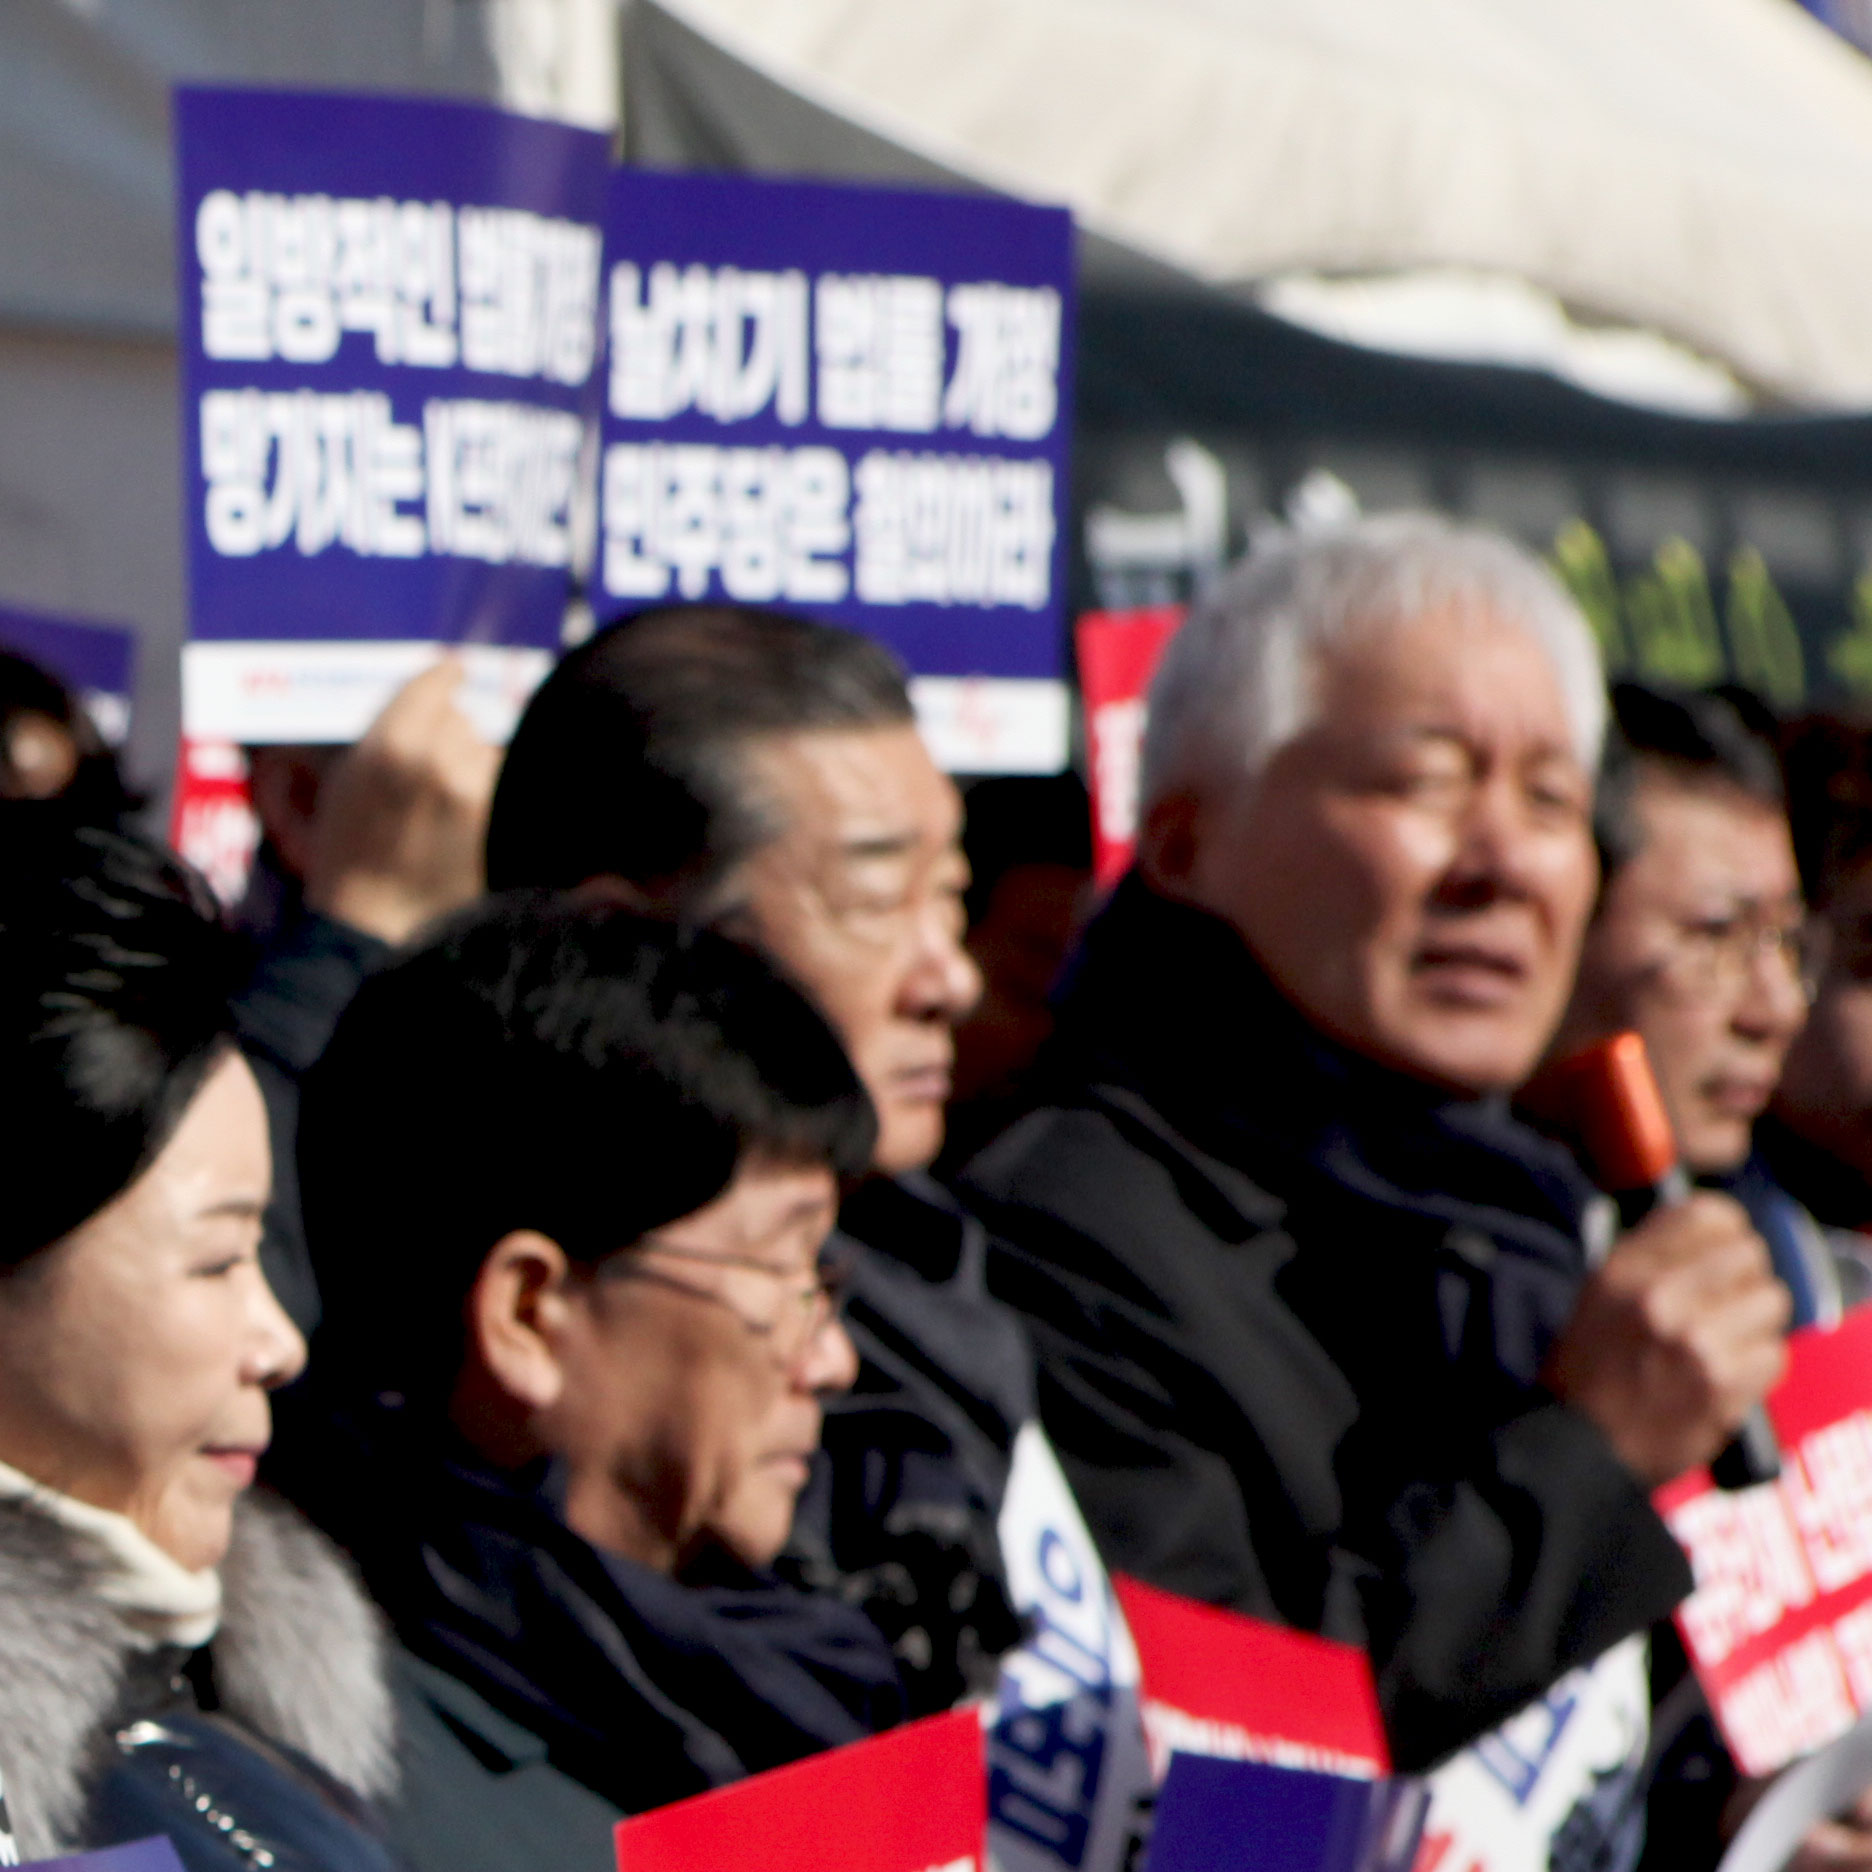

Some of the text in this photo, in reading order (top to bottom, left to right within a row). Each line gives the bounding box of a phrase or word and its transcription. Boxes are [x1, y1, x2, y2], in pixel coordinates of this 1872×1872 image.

[195, 190, 458, 369] 일방적인
[609, 258, 812, 427] 날치기
[199, 387, 427, 559] 망가지는
[602, 440, 853, 604] 민주당은
